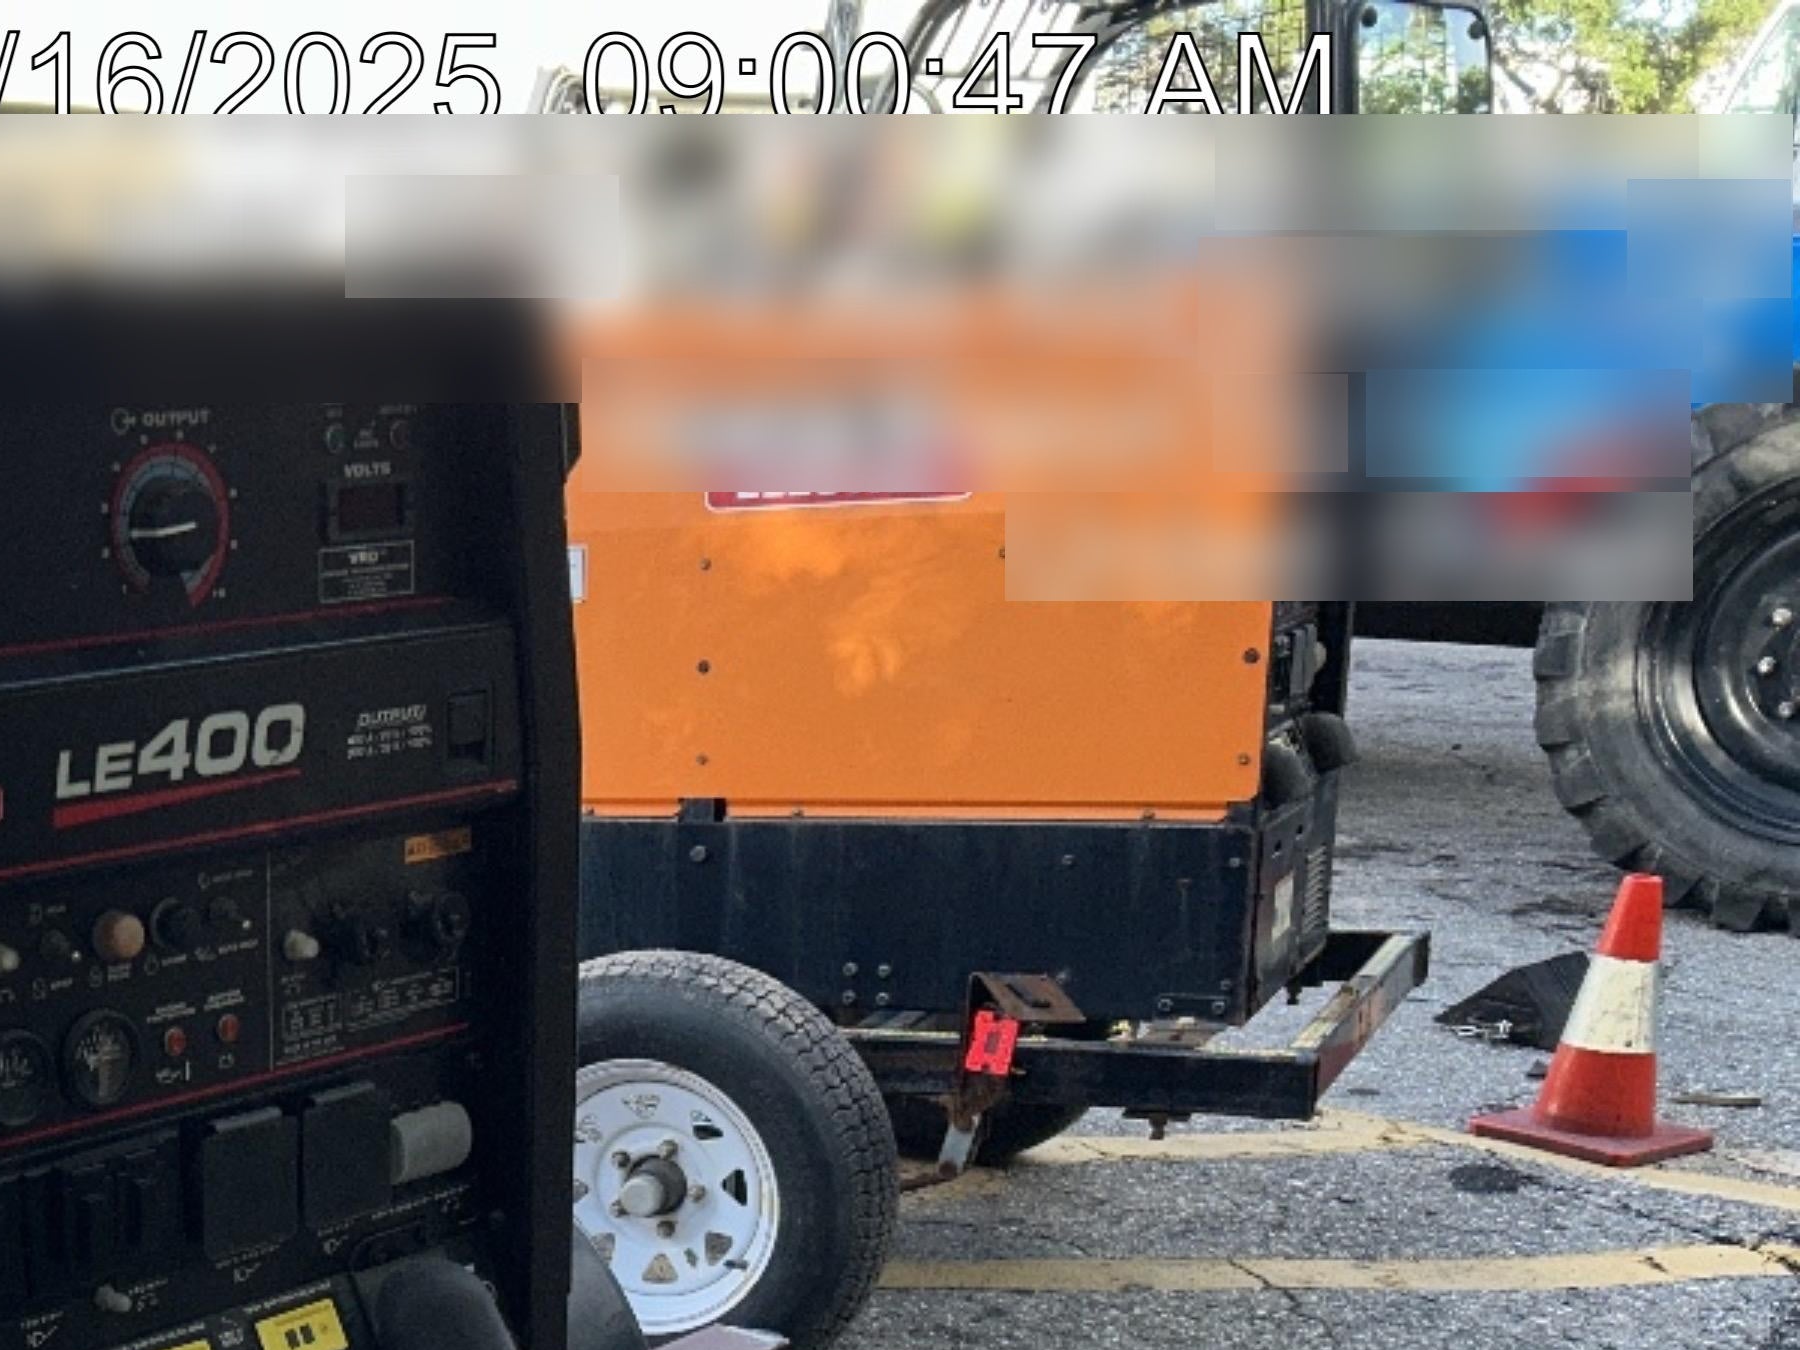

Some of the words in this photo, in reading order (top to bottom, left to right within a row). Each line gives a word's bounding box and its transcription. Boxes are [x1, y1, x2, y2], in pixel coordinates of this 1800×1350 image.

[143, 409, 210, 428] OUTPUT
[344, 460, 391, 479] VOLTS
[55, 702, 305, 800] LE400
